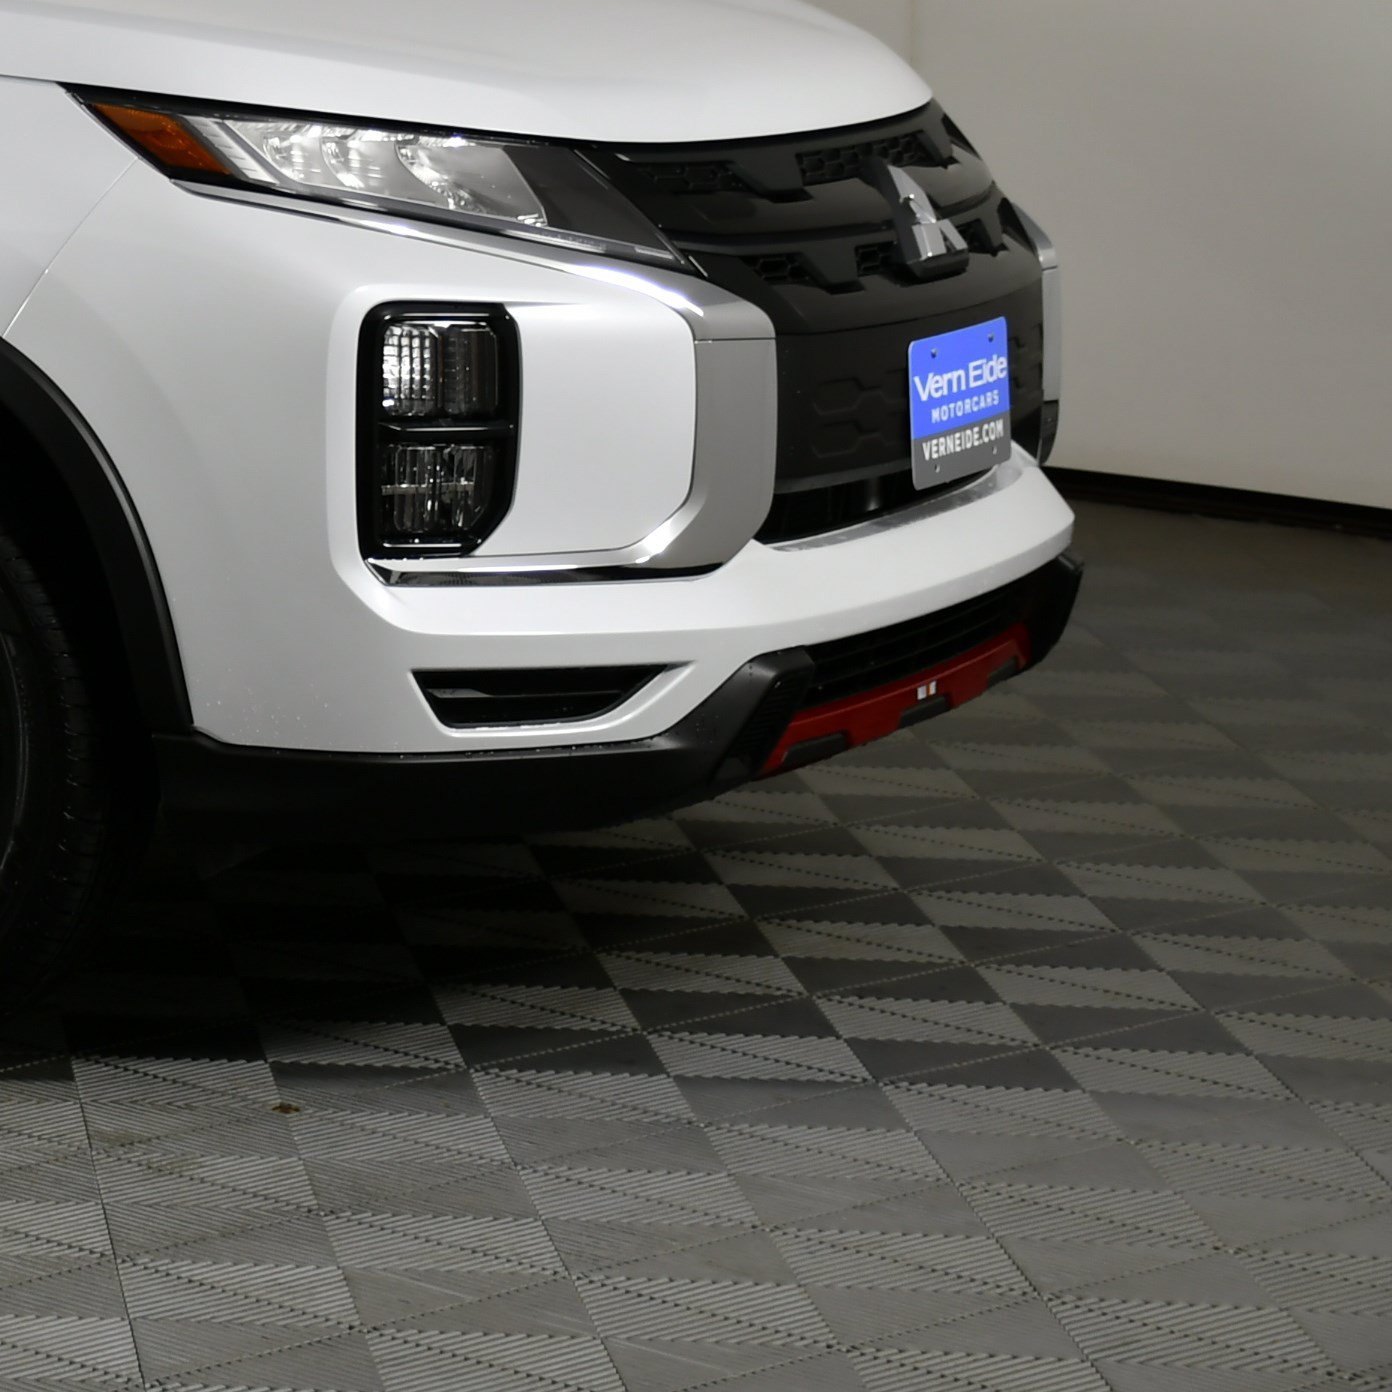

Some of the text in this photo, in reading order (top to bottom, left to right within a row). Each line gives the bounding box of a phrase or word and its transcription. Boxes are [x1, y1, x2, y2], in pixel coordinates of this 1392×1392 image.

[913, 354, 1008, 402] Vern Eide
[931, 389, 1000, 424] MOTORCARS
[922, 418, 1004, 461] VERNEIDE.COM
